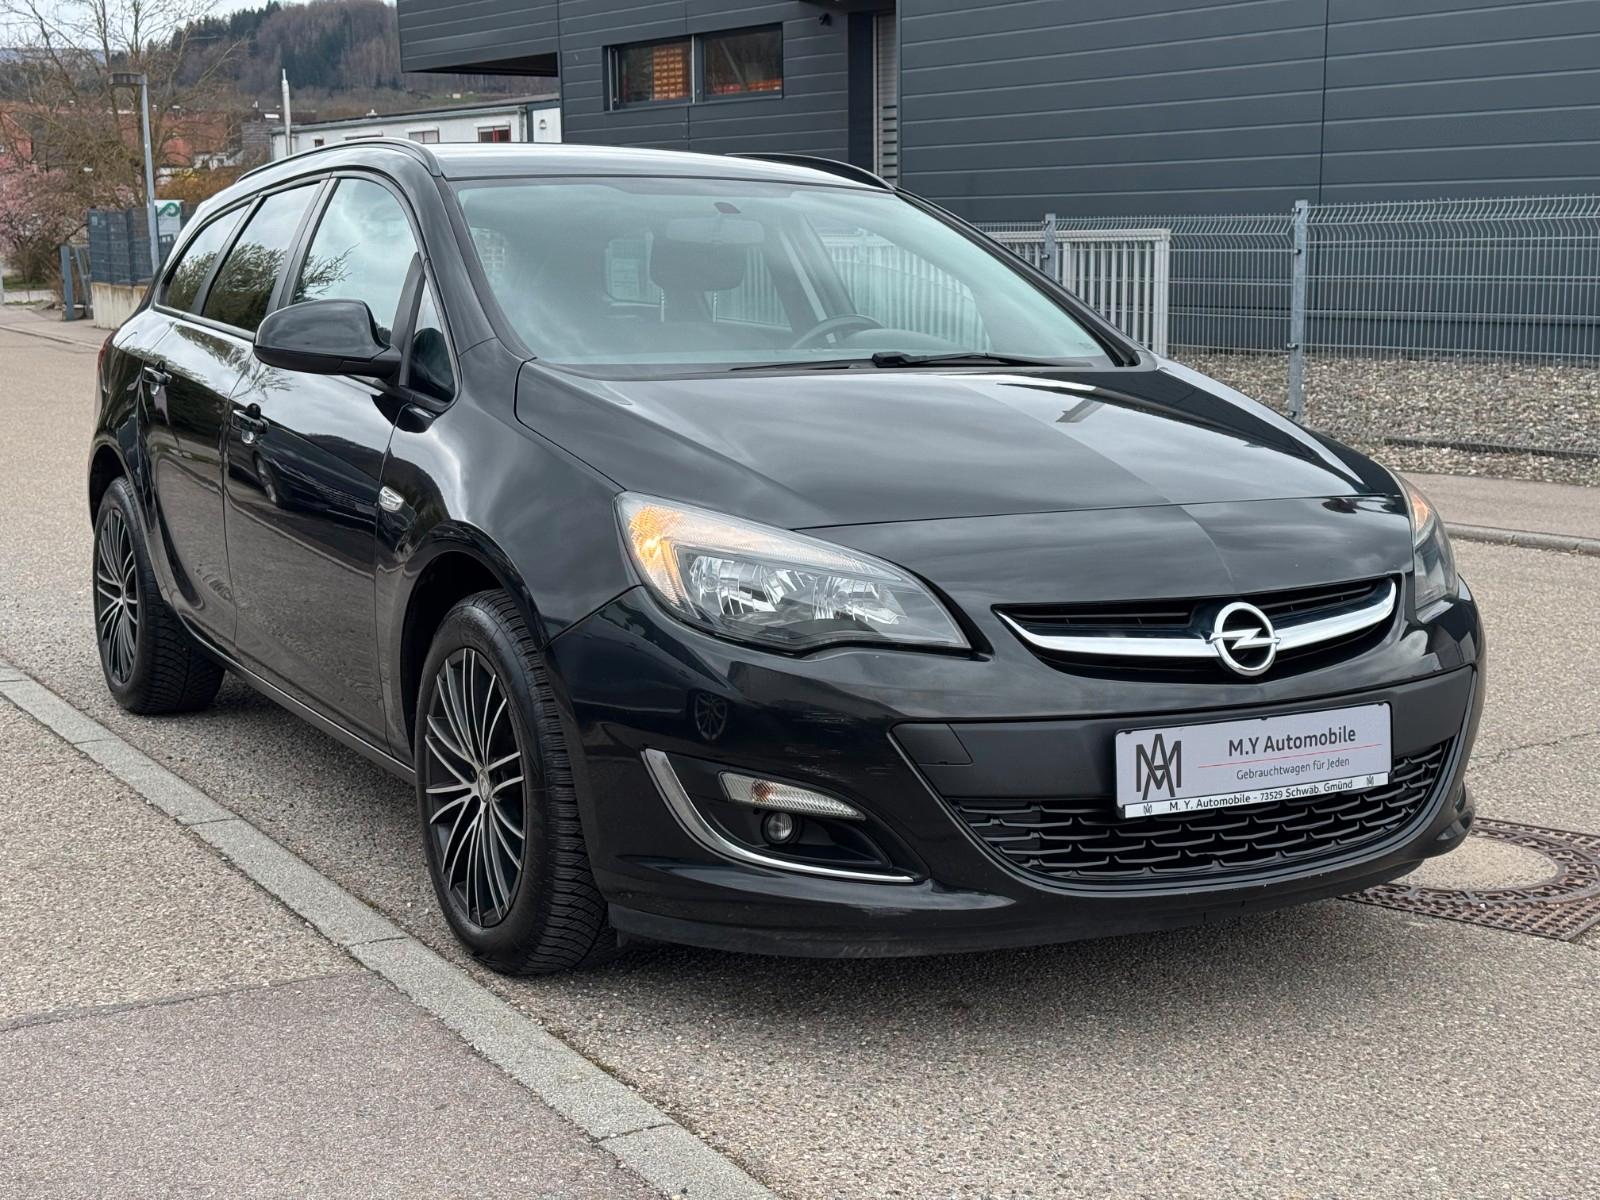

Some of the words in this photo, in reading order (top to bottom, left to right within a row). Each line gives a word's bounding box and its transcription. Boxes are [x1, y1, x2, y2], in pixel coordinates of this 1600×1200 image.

[1228, 737, 1259, 756] M.Y
[1263, 725, 1356, 753] Automobile
[1236, 763, 1311, 780] Gebrauchtwagen
[1313, 760, 1325, 772] für
[1327, 757, 1350, 770] Jeden
[1169, 801, 1180, 812] M.
[1184, 800, 1193, 810] Y.
[1196, 794, 1251, 808] Automobile
[1260, 791, 1283, 801] 73529
[1323, 780, 1353, 793] Gmünd
